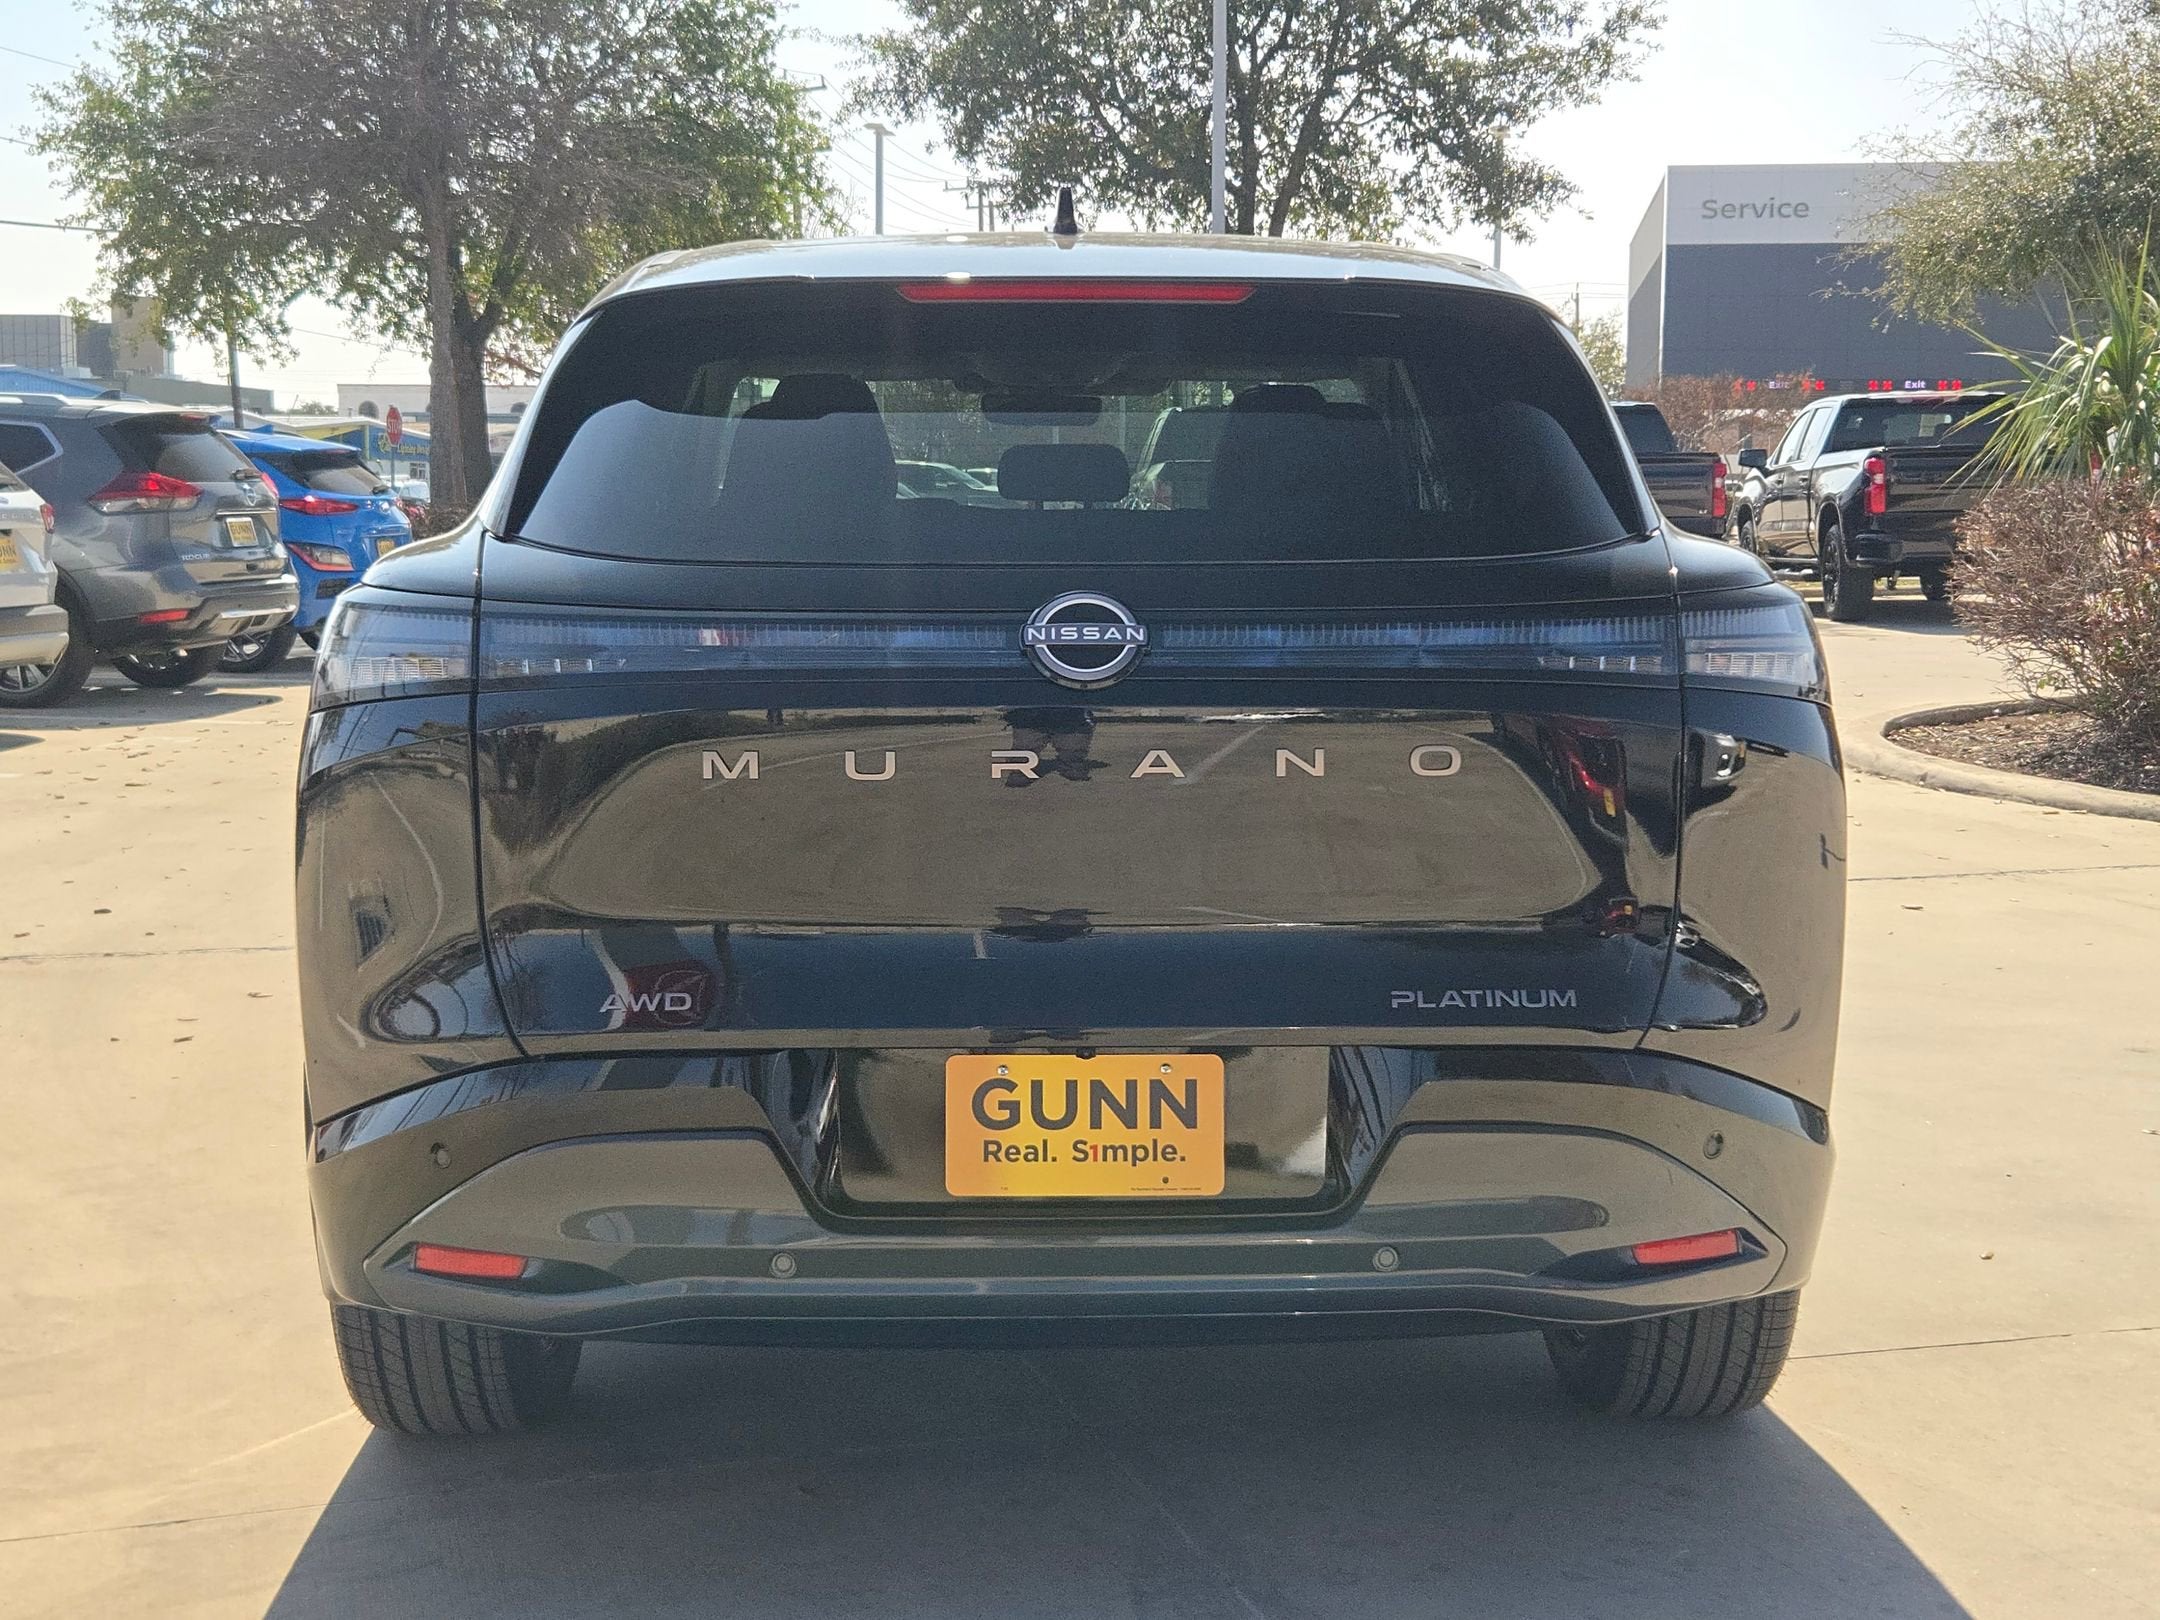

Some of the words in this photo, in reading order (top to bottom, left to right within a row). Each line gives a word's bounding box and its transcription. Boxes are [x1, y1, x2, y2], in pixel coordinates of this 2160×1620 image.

[1701, 197, 1809, 219] Service
[1904, 379, 1927, 389] Exit
[1028, 626, 1145, 641] NISSAN
[702, 743, 1462, 781] MURANO
[599, 992, 693, 1013] AWD
[1390, 989, 1577, 1009] PLATINUM
[971, 1076, 1198, 1131] GUNN
[983, 1138, 1058, 1163] Real.
[1071, 1138, 1187, 1168] S1mple.
